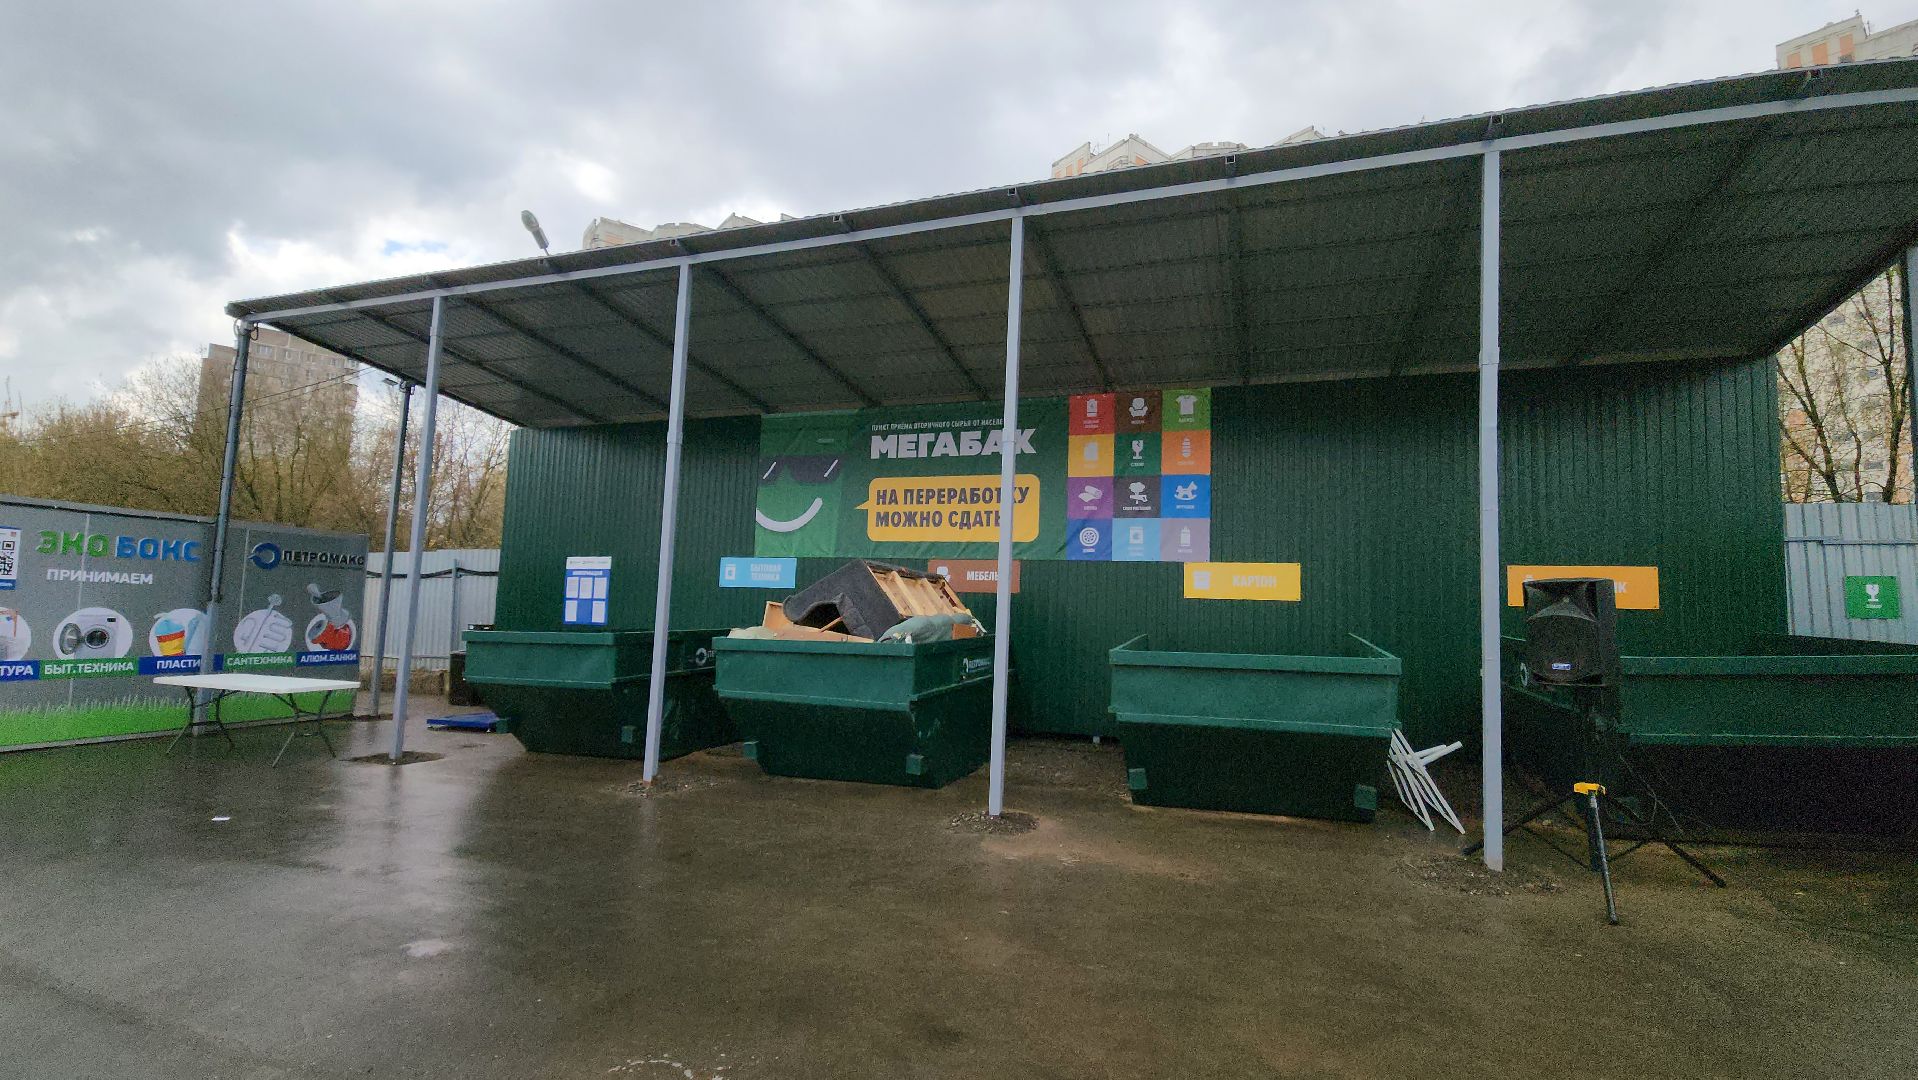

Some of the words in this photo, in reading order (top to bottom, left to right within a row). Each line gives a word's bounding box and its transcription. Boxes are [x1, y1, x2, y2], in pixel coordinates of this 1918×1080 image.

[913, 421, 950, 429] ВТОРИЧНОГО
[972, 419, 981, 427] ОТ
[981, 418, 1003, 426] НАСЕЛЕ
[870, 428, 1037, 460] МЕГАБАК
[876, 489, 899, 506] НА
[903, 486, 1030, 505] ПЕРЕРАБОТУ
[875, 510, 943, 528] МОЖНО
[35, 529, 110, 558] ЭКО
[115, 535, 201, 563] БОКС
[282, 549, 365, 566] ПЕТРОМАКС
[46, 569, 153, 585] ПРИНИМАЕМ
[1232, 575, 1277, 589] КАРТОН
[44, 661, 134, 675] БЫТ.ТЕХНИКА
[156, 659, 201, 669] ПЛАСТИ
[226, 656, 293, 666] САНТЕХНИКА
